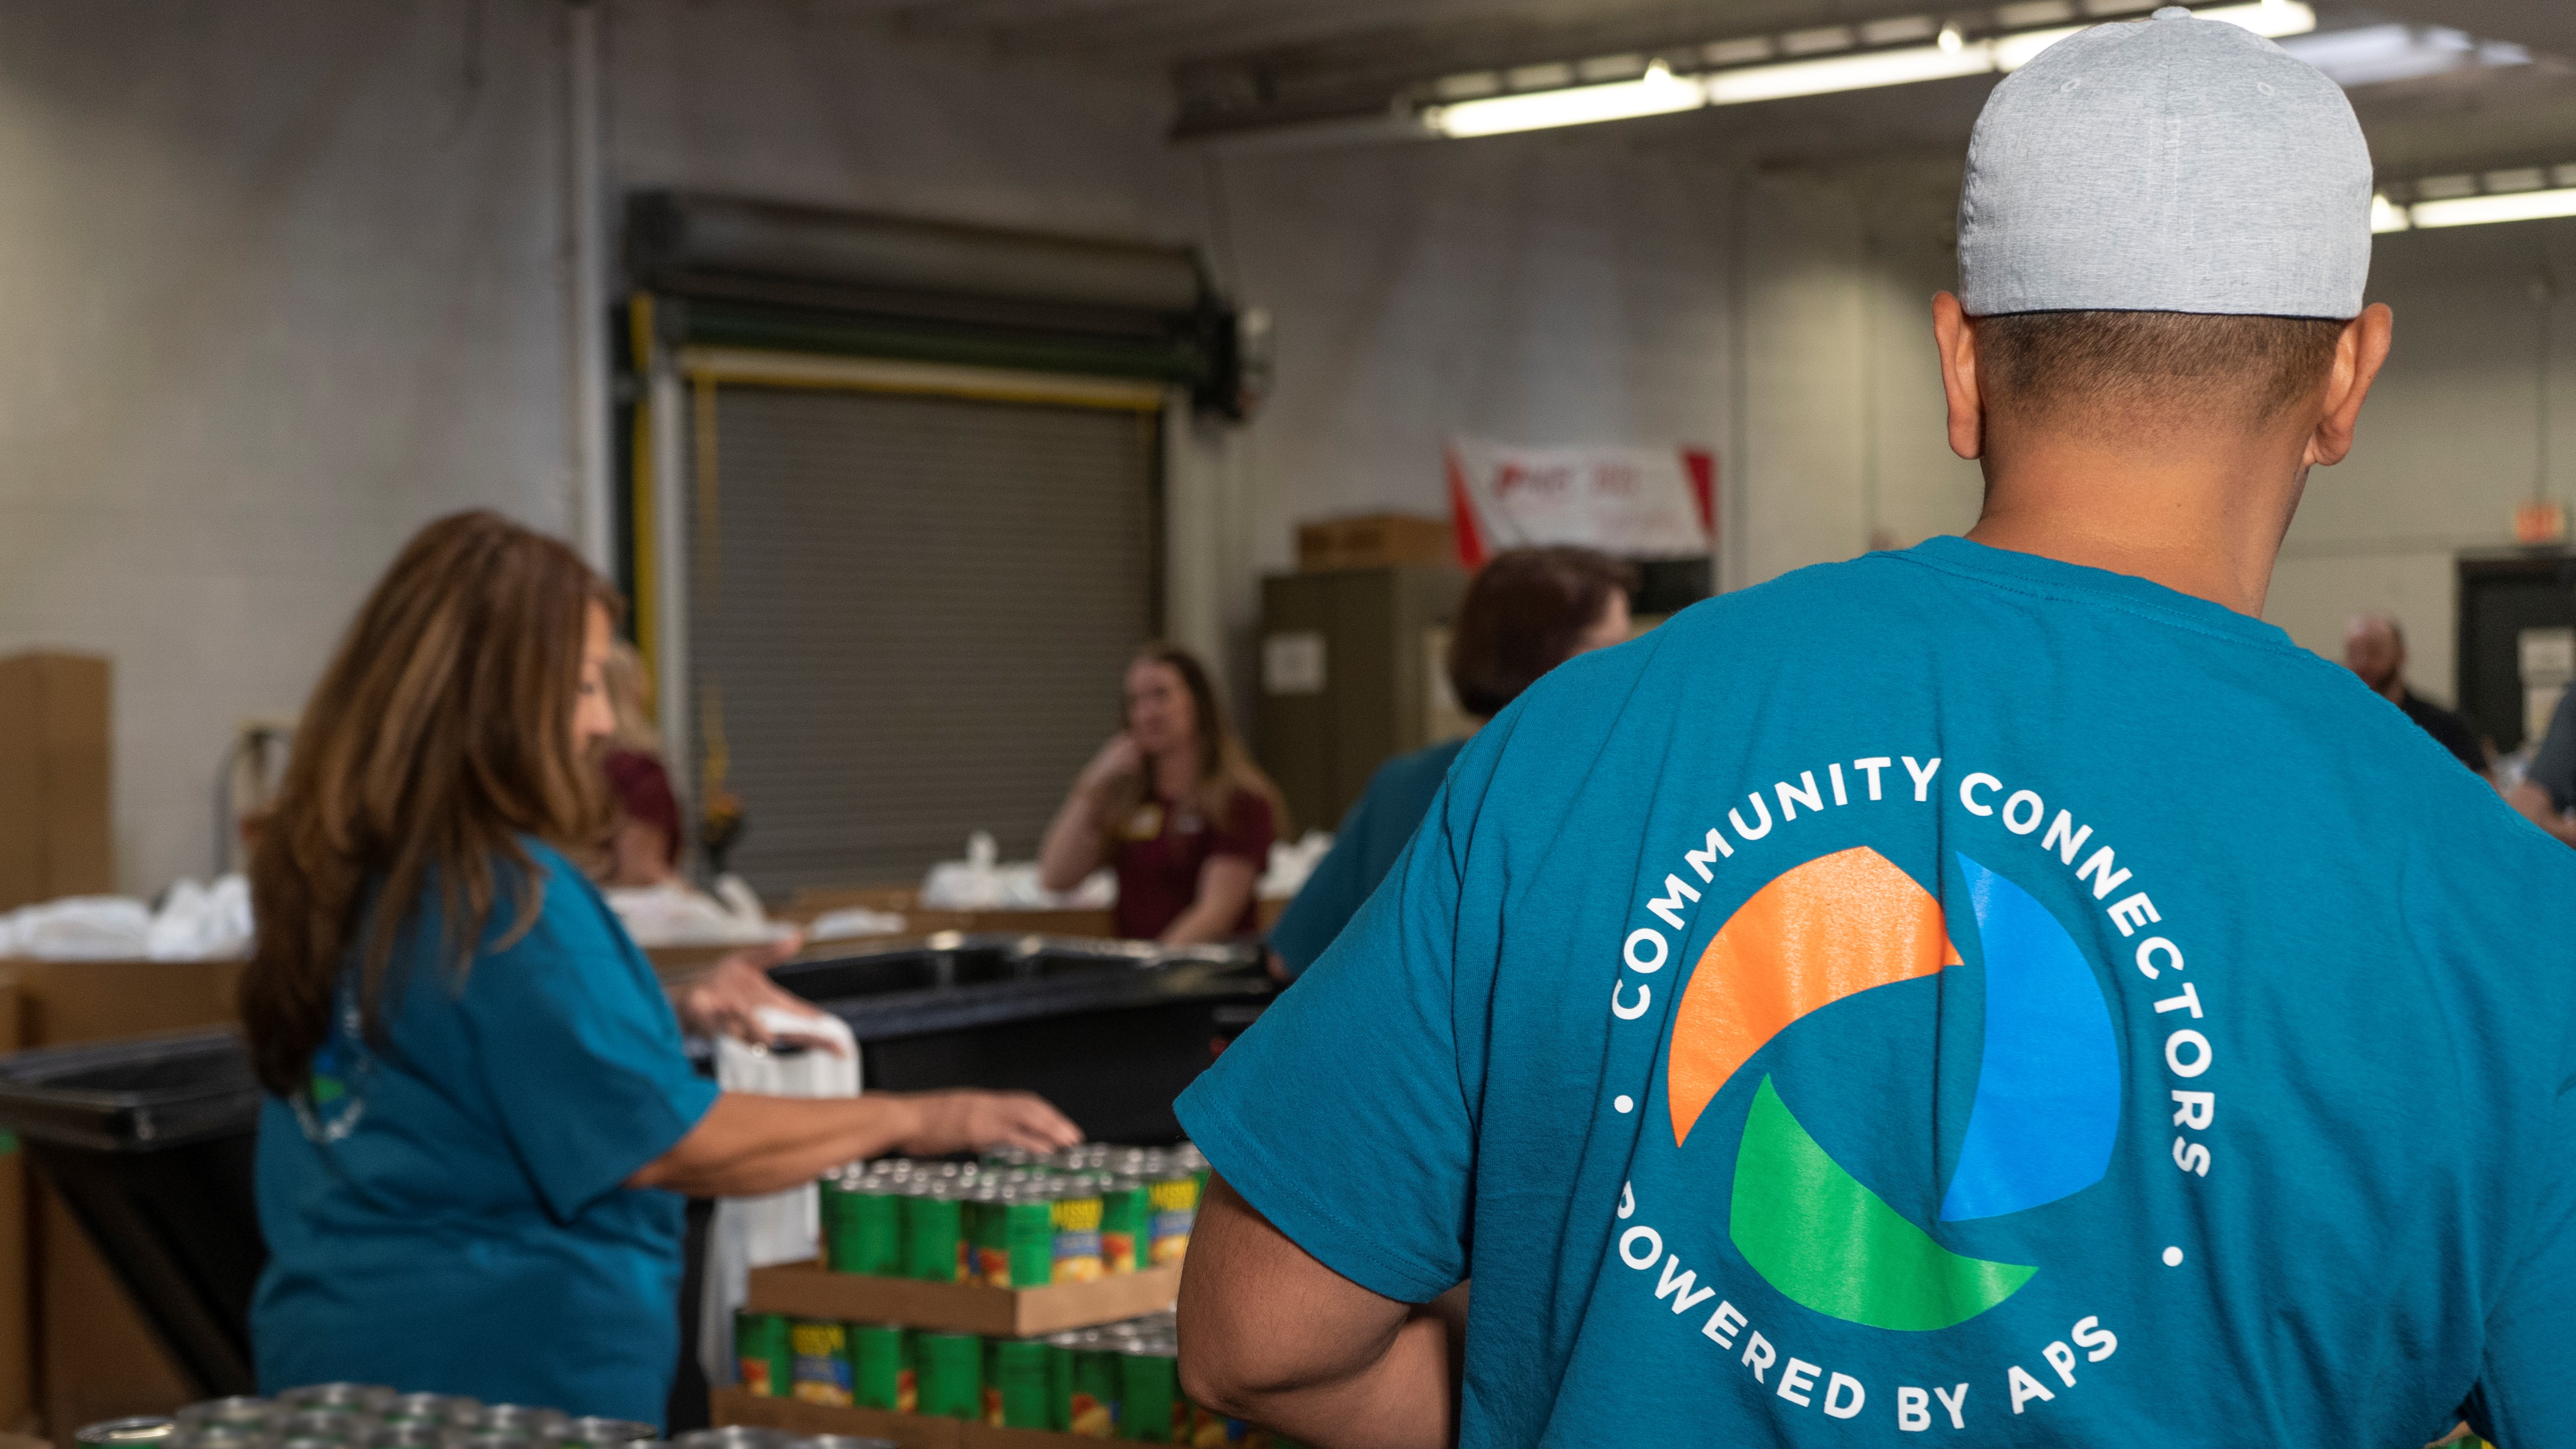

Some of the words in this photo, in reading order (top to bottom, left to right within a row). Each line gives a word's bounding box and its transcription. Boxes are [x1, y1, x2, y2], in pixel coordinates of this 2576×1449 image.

[1611, 755, 1941, 1020] COMMUNITY
[1959, 771, 2215, 1178] CONNECTORS
[1897, 1382, 1969, 1432] BY
[2007, 1315, 2118, 1415] APS
